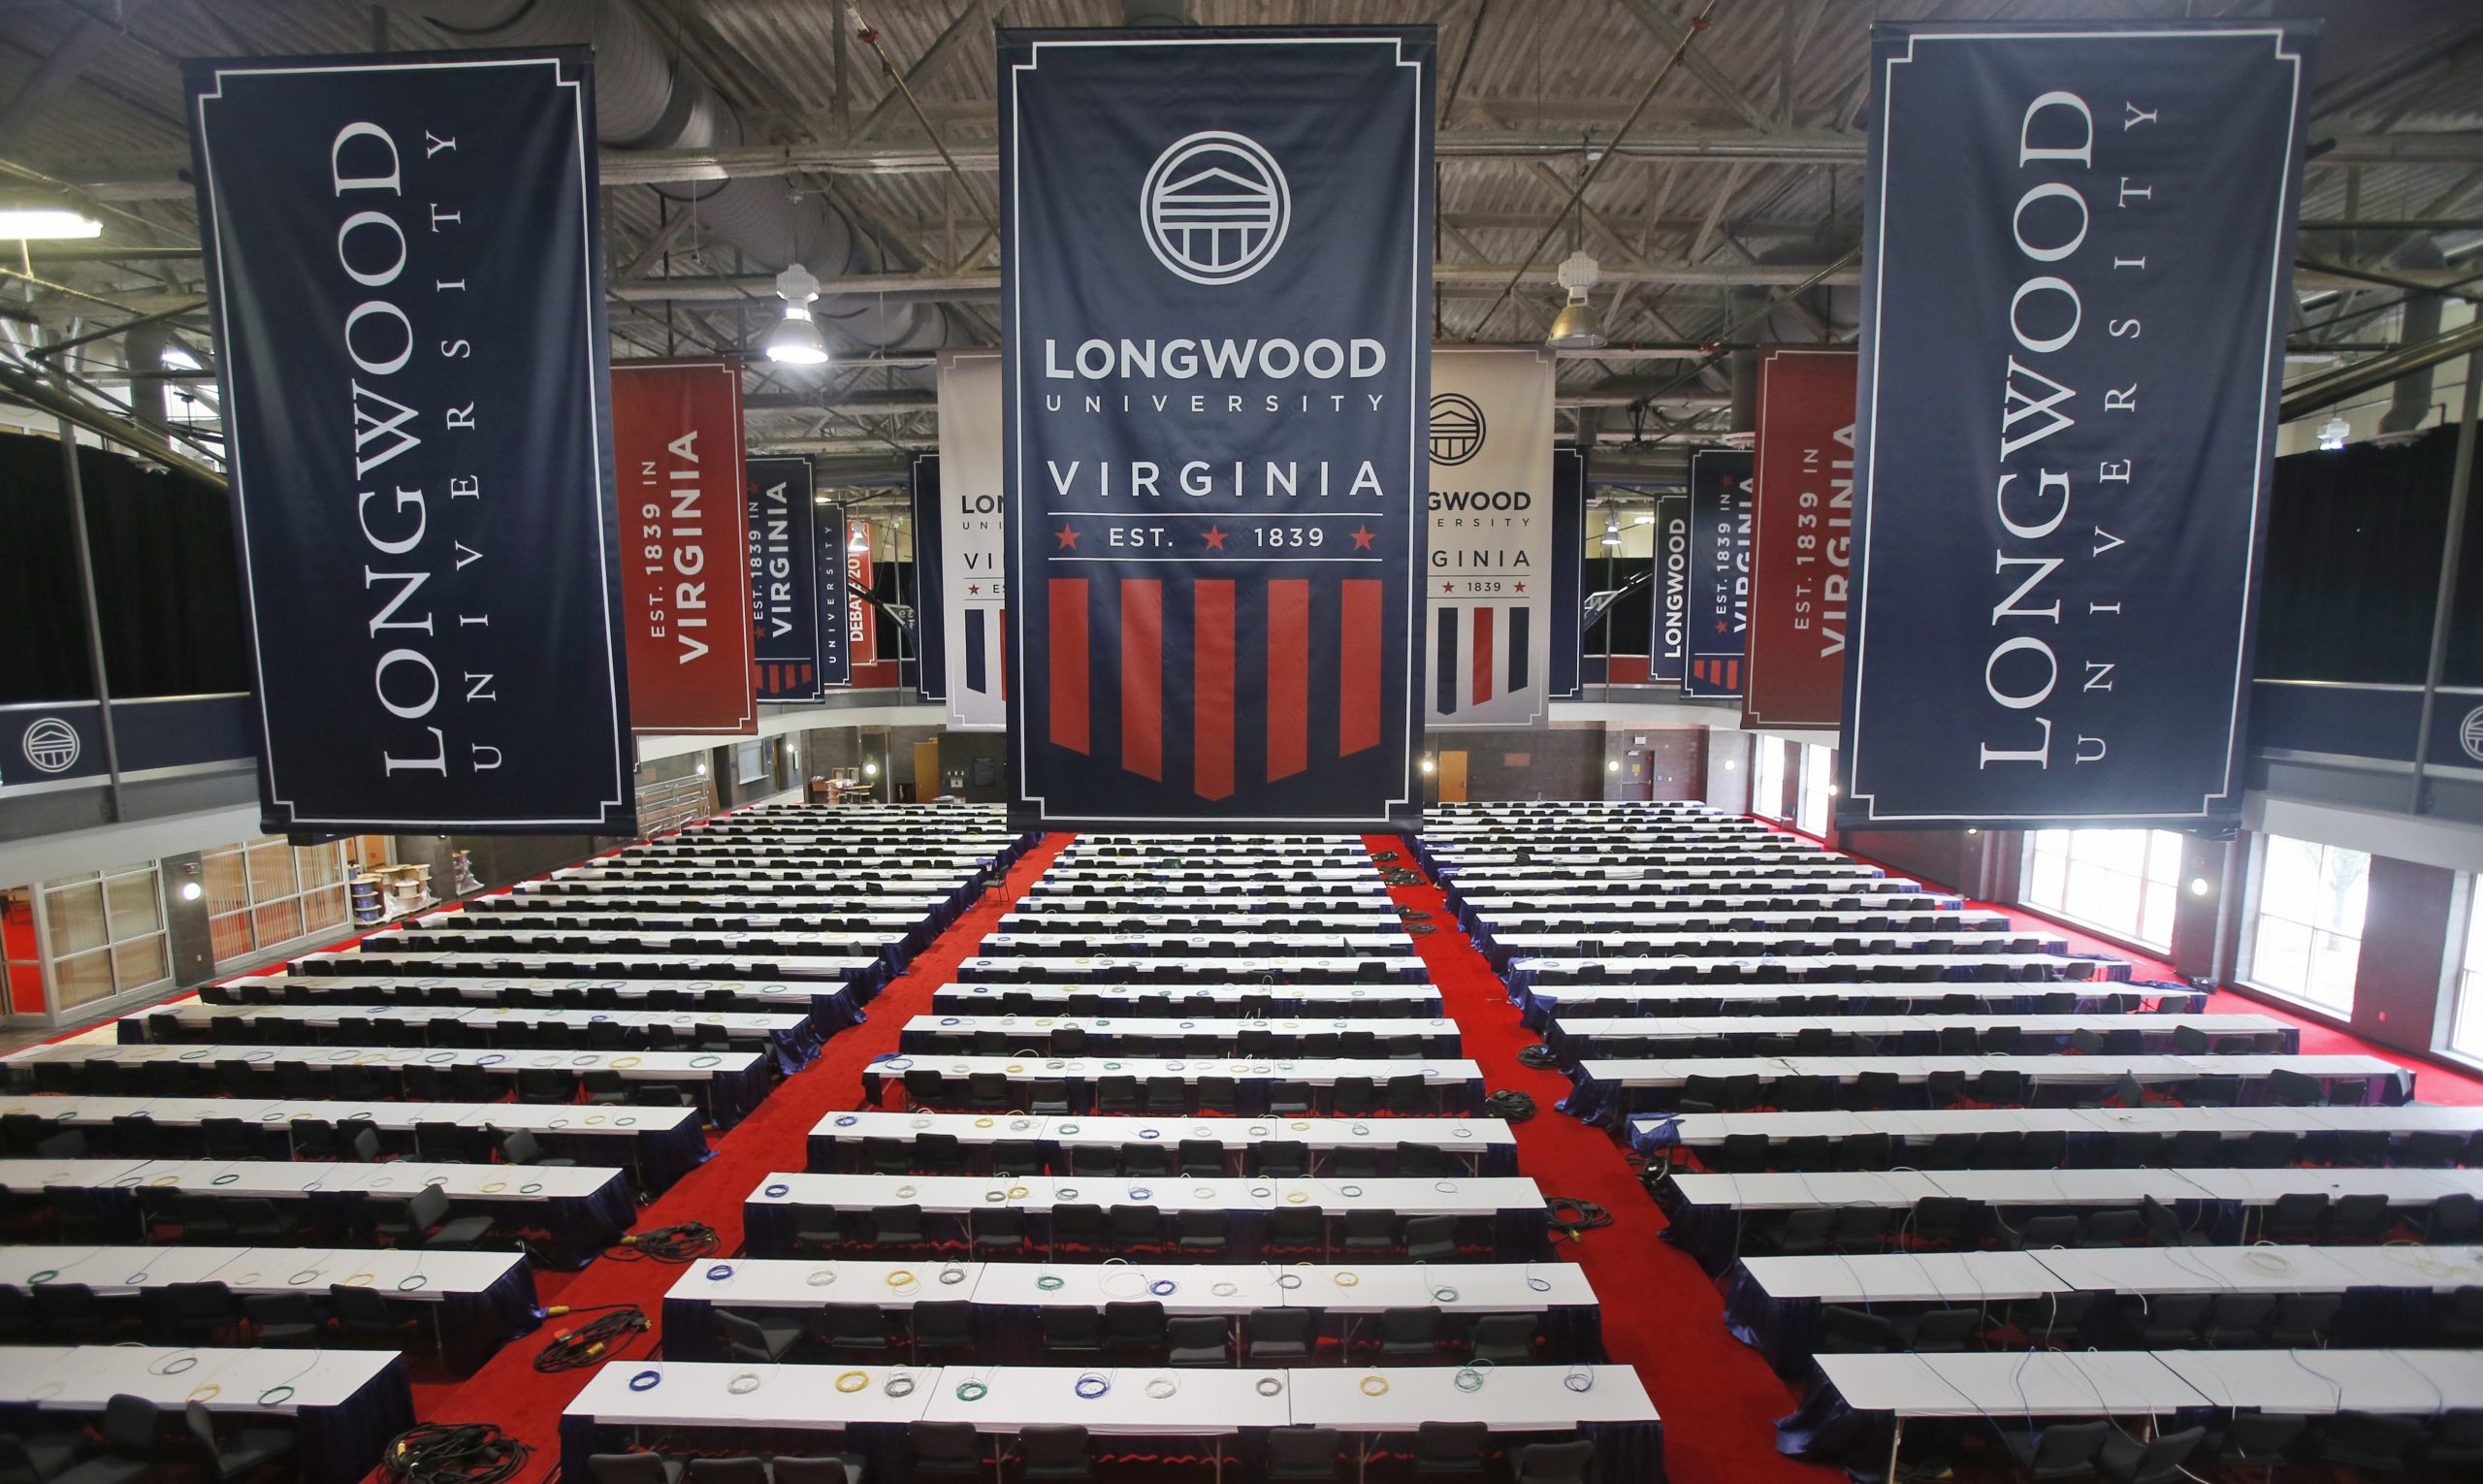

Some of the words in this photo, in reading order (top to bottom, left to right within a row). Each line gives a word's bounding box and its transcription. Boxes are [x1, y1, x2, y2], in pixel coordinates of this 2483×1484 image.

[1046, 339, 1386, 379] LONGWOOD
[1047, 394, 1383, 412] UNIVERSITY
[332, 121, 448, 779] LONGWOOD
[425, 130, 502, 773] UNIVERSITY
[1980, 91, 2094, 770] LONGWOOD
[2076, 101, 2157, 764] UNIVERSITY
[641, 461, 658, 485] IN
[1047, 460, 1384, 497] VIRGINIA
[1803, 449, 1819, 473] IN
[748, 501, 759, 519] IN
[1428, 491, 1532, 511] GWOOD
[1720, 494, 1731, 511] IN
[642, 503, 663, 575] 1839
[668, 430, 709, 664] VIRGINIA
[1110, 528, 1173, 547] EST.
[1254, 528, 1324, 547] 1839
[1716, 522, 1731, 572] 1839
[1796, 492, 1819, 565] 1839
[1821, 423, 1855, 658] VIRGINIA
[748, 530, 763, 578] 1839
[766, 481, 793, 638] VIRGINIA
[847, 553, 862, 579] 201
[649, 587, 665, 637] EST.
[753, 584, 764, 621] EST.
[824, 527, 837, 663] UNIVERSITY
[1467, 582, 1501, 593] 1839
[1664, 518, 1686, 658] LONGWOOD
[1716, 578, 1728, 615] EST.
[1794, 577, 1812, 629] EST.
